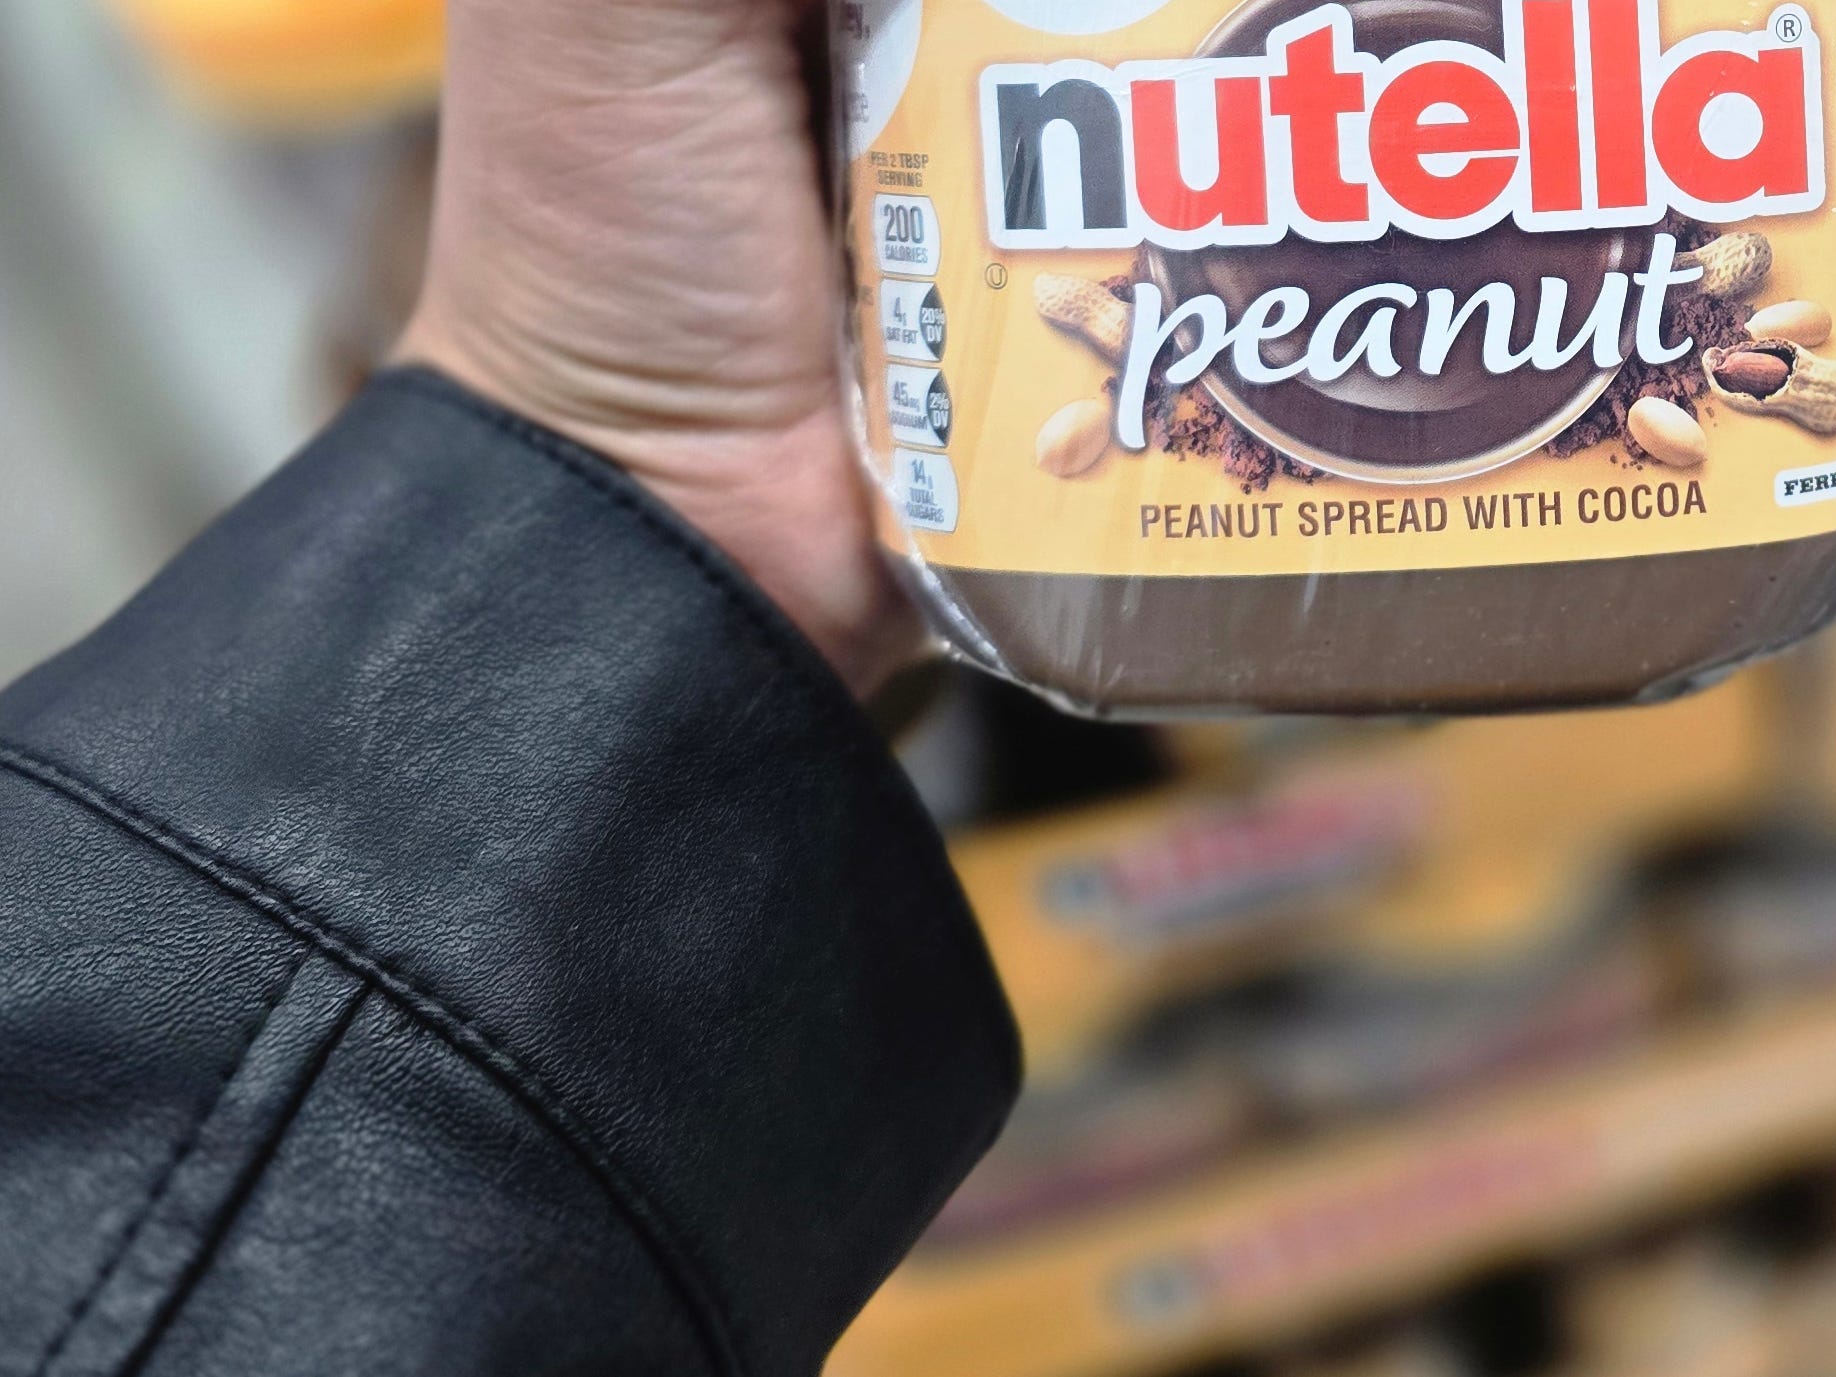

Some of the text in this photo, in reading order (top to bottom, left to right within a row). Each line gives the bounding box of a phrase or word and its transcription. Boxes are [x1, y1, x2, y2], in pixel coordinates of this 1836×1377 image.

[884, 202, 925, 245] 200
[1116, 232, 1705, 451] peanut
[1139, 479, 1708, 539] PEANUT SPREAD WITH COCOA
